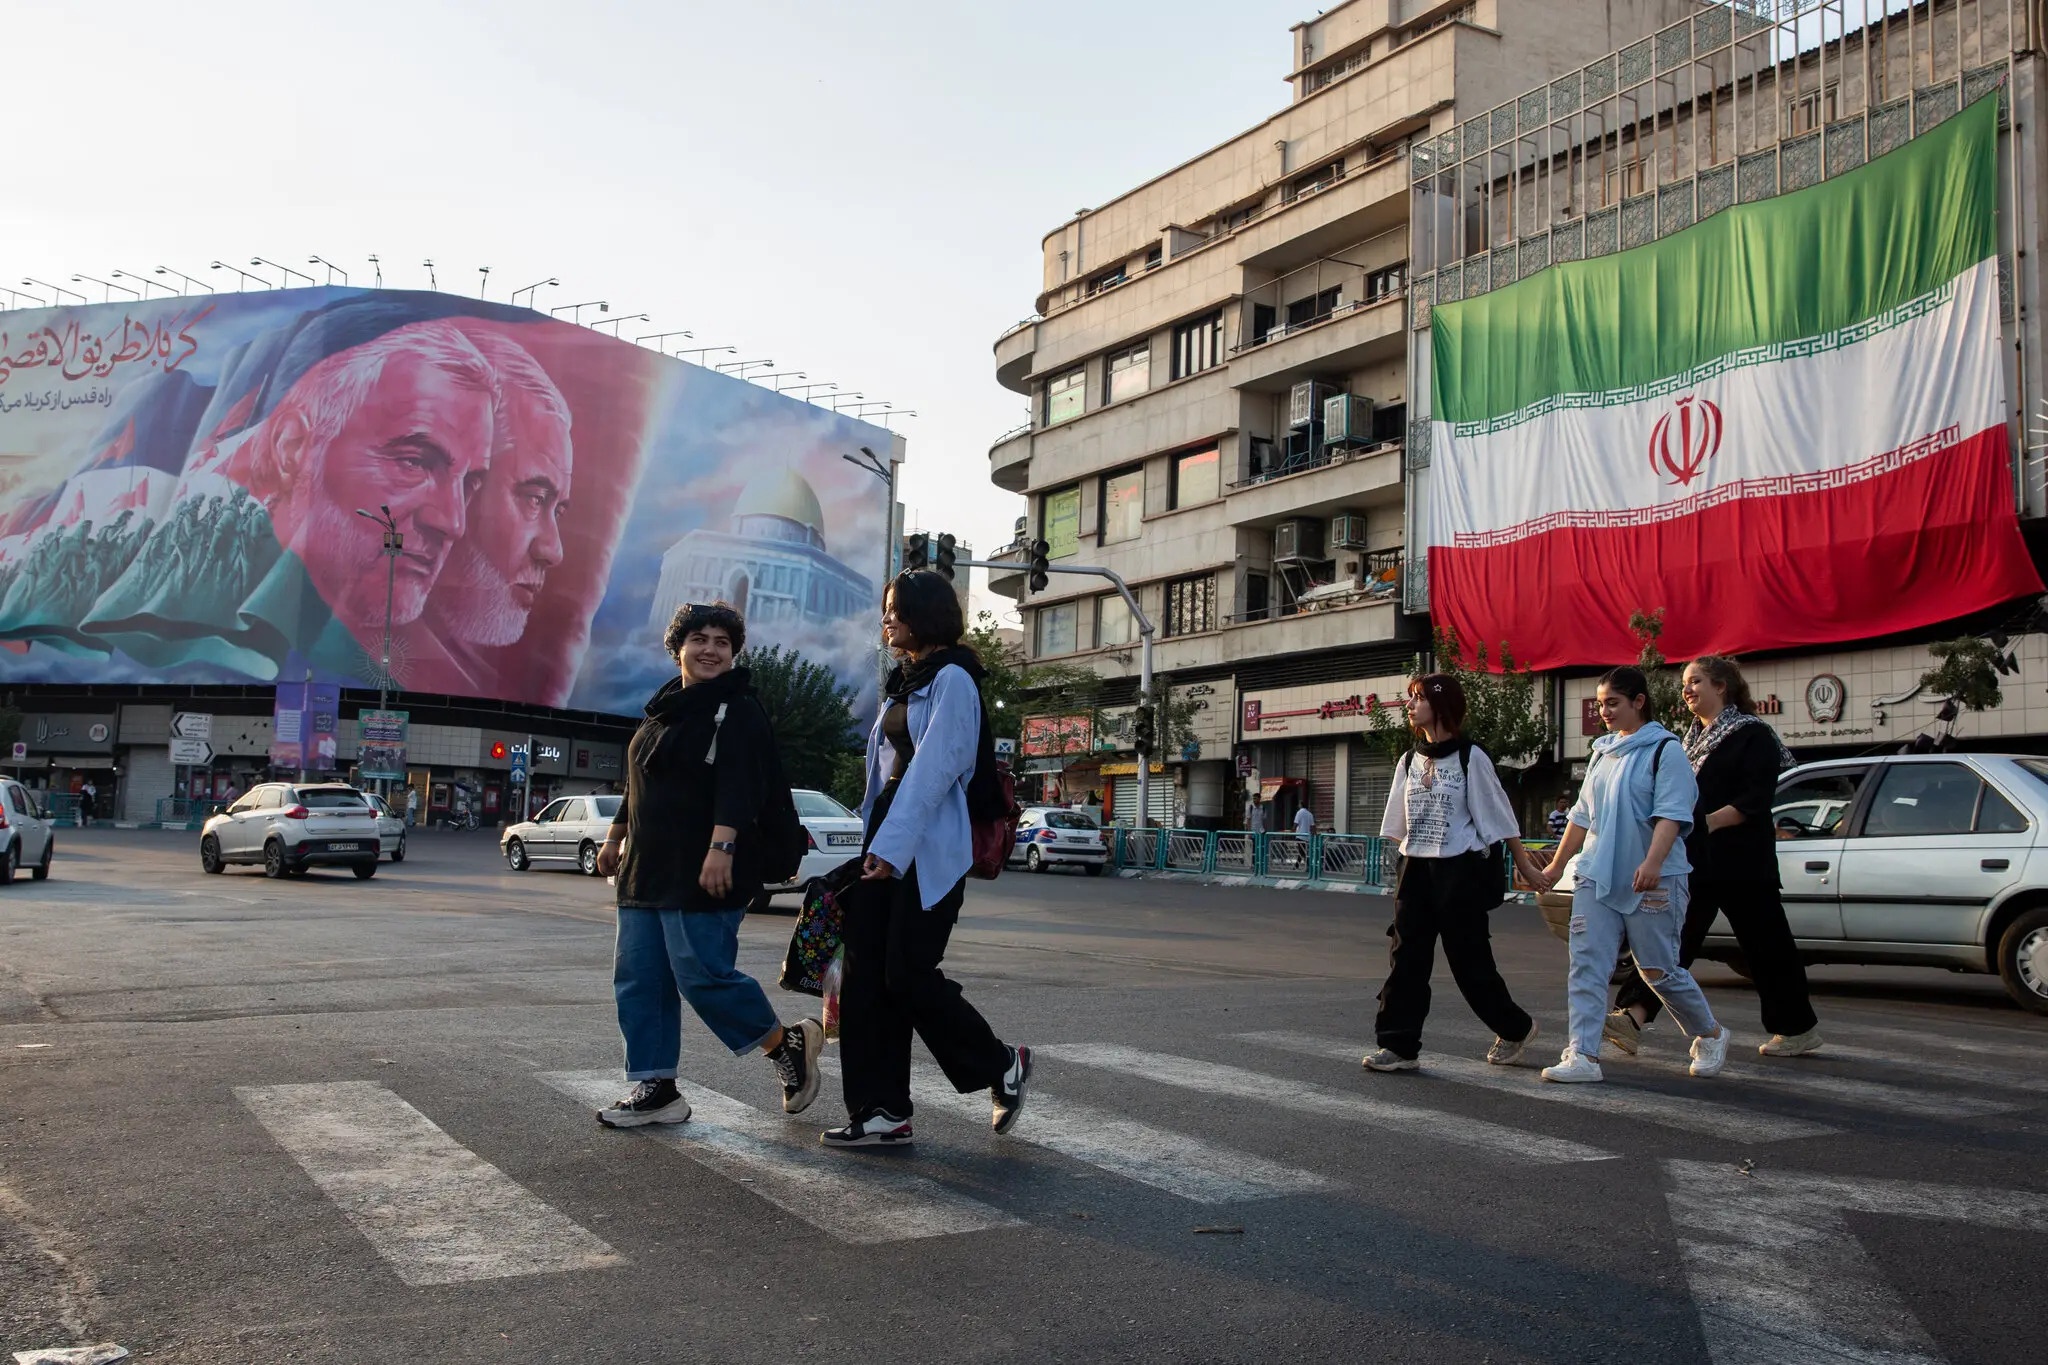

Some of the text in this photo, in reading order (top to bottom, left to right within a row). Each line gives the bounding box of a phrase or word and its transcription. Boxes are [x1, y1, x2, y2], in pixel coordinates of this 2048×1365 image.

[24, 390, 52, 412] کربلا
[49, 389, 62, 411] از
[61, 386, 97, 410] قدس
[98, 387, 112, 408] راه
[1429, 792, 1452, 801] WIFE
